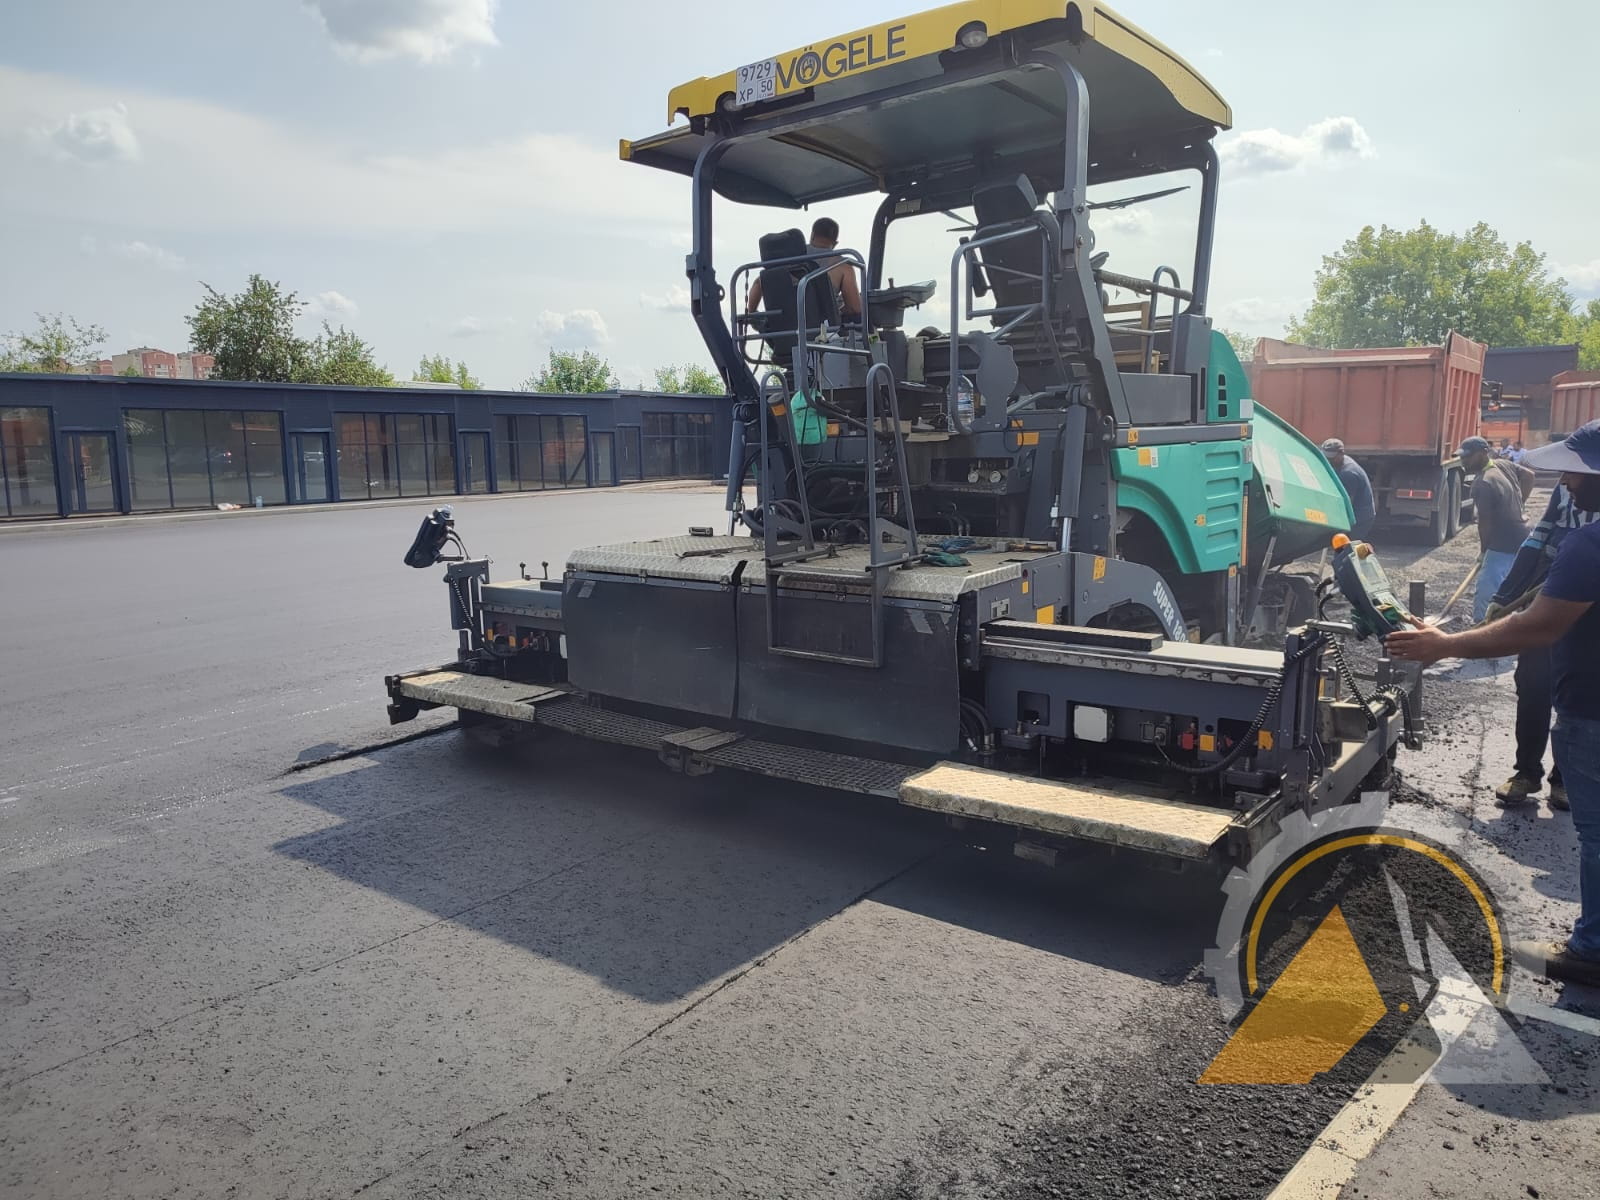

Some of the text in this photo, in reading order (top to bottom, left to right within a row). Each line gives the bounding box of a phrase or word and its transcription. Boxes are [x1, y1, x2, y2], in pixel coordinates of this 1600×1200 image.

[741, 61, 771, 83] 9729
[776, 24, 906, 89] VÖGELE
[761, 79, 773, 93] 50
[1153, 581, 1175, 627] SUPER
